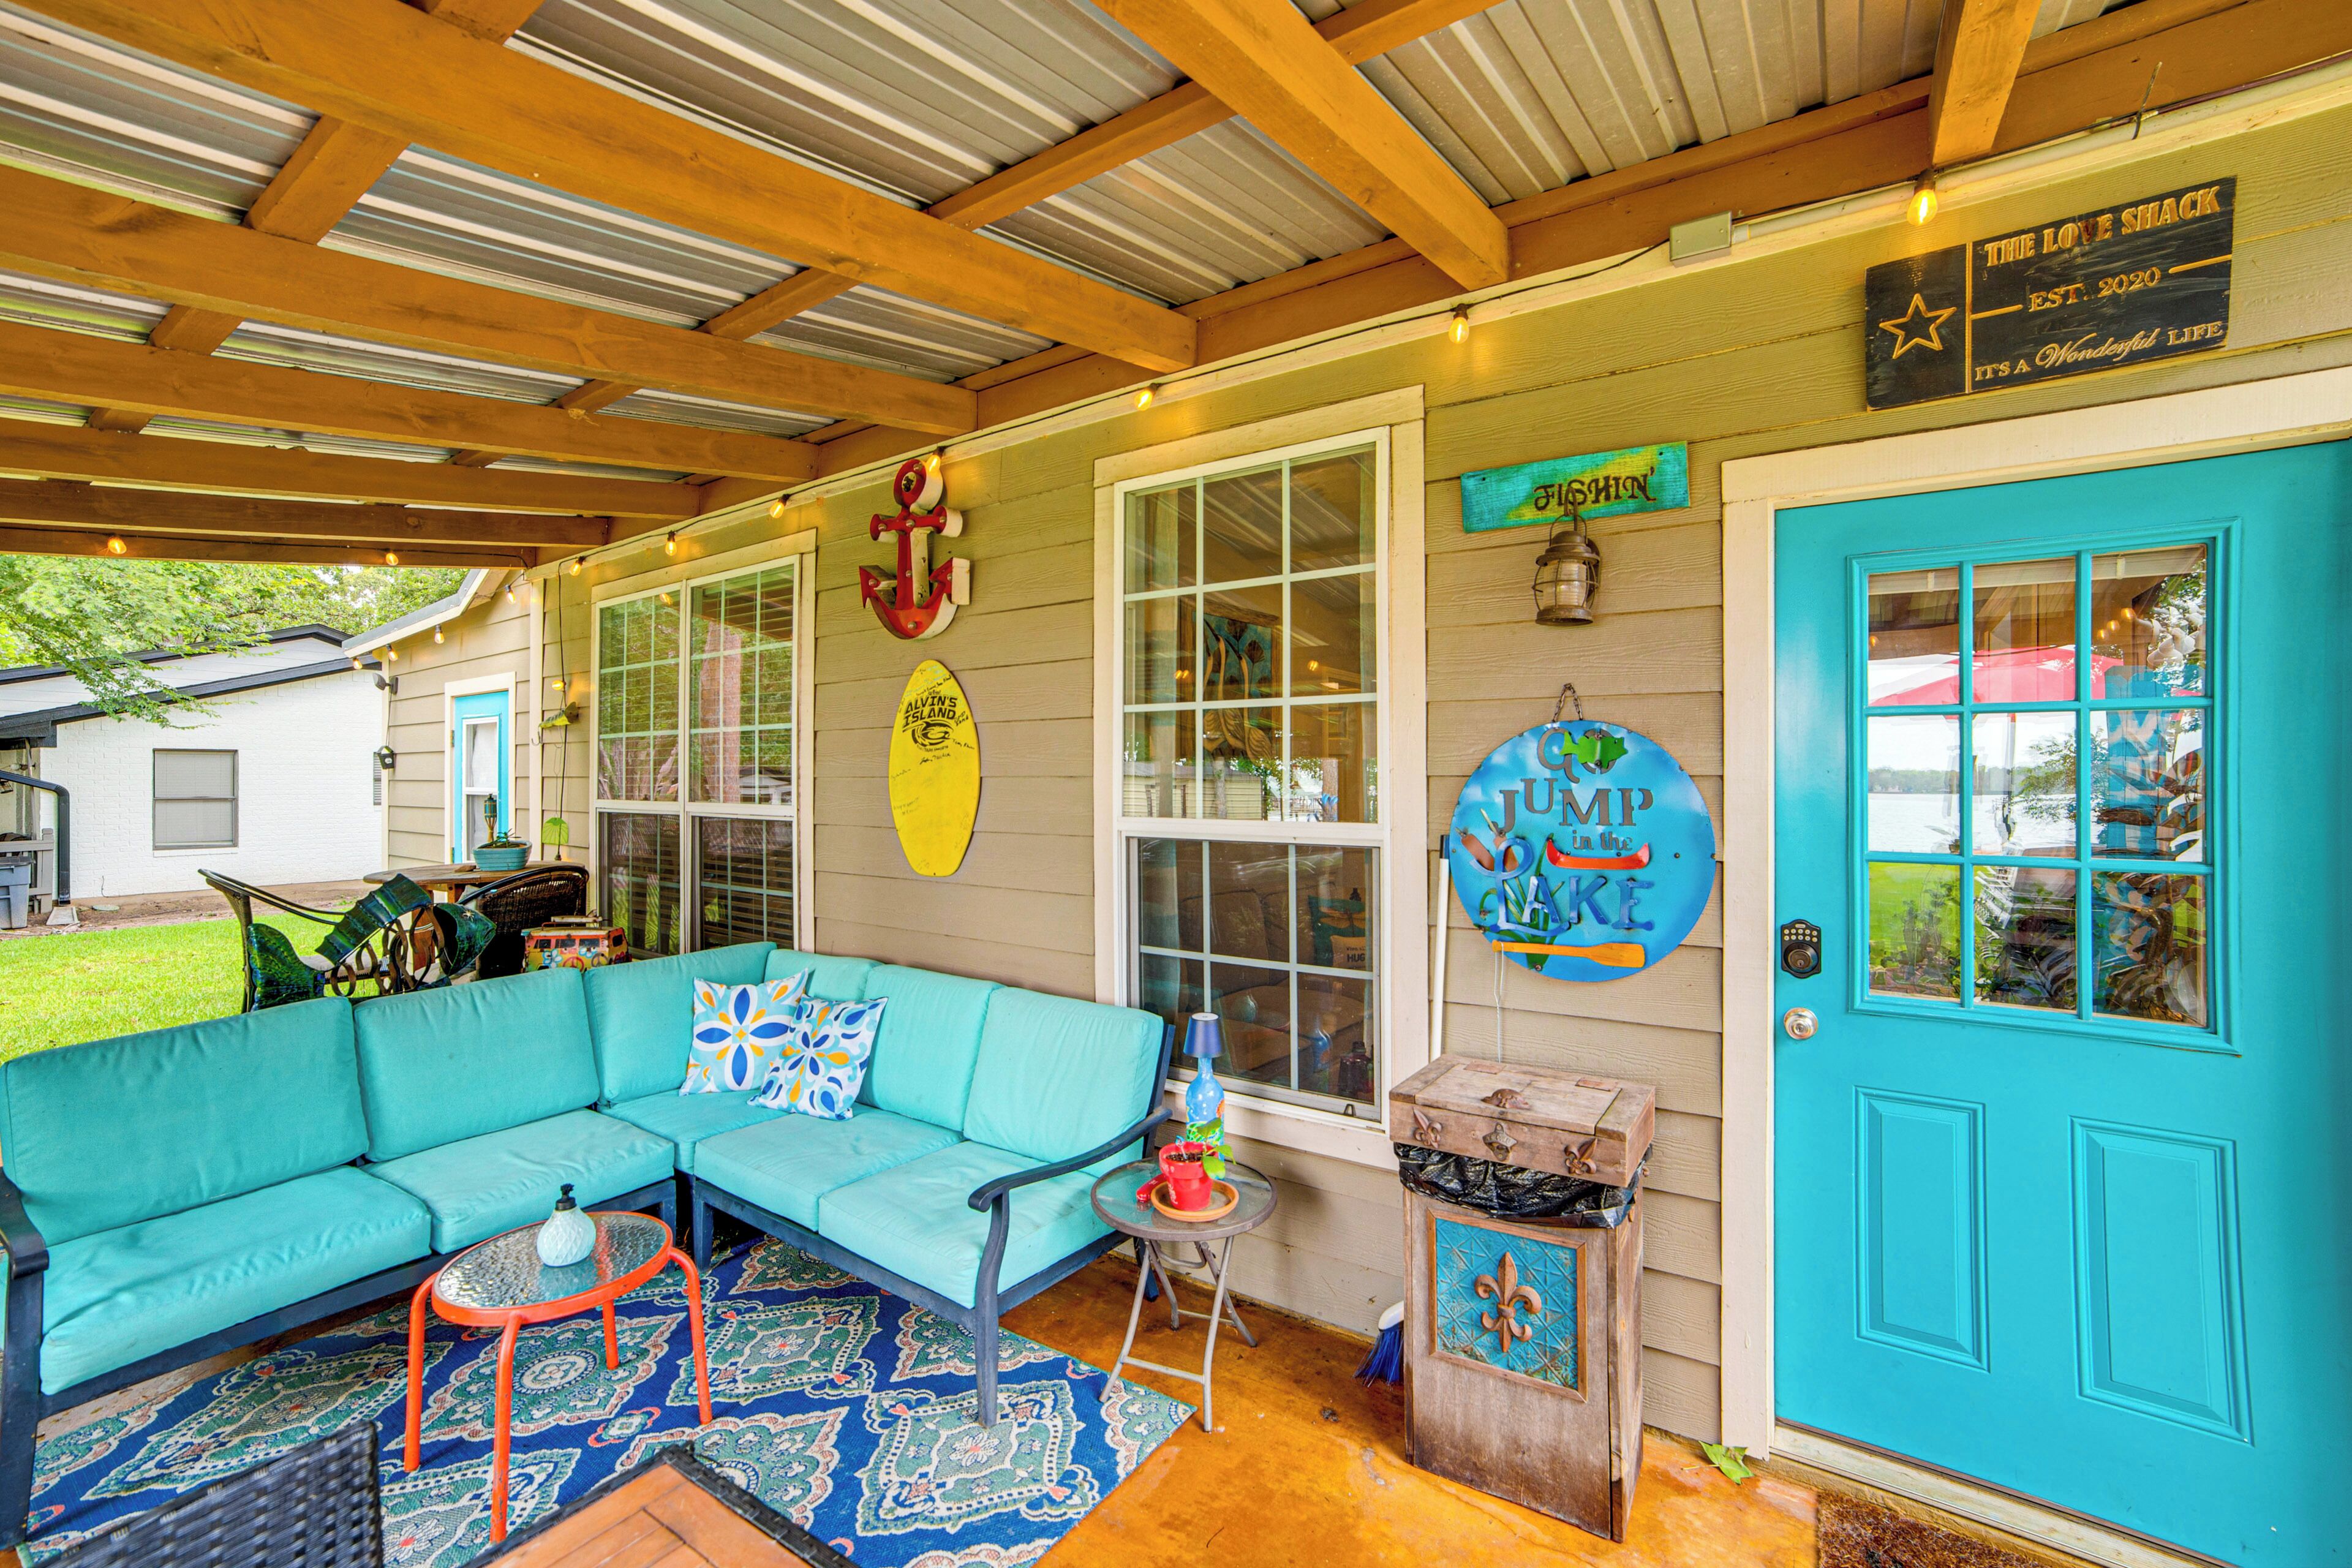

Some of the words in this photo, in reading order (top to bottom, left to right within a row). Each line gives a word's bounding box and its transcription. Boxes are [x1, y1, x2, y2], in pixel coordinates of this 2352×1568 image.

[1985, 233, 2035, 267] THE
[2043, 213, 2113, 255] LOVE
[2122, 186, 2221, 235] SHACK
[2029, 282, 2092, 312] EST.
[2097, 266, 2162, 298] 2020
[2013, 359, 2032, 374] A
[2035, 328, 2161, 369] Wonderful
[2166, 321, 2223, 345] LIFE
[902, 707, 956, 728] ISLAND
[905, 695, 958, 715] ALVIN'S
[1492, 778, 1654, 833] JUMP
[1572, 829, 1594, 850] in
[1600, 831, 1633, 851] the
[1469, 837, 1654, 937] LAKE
